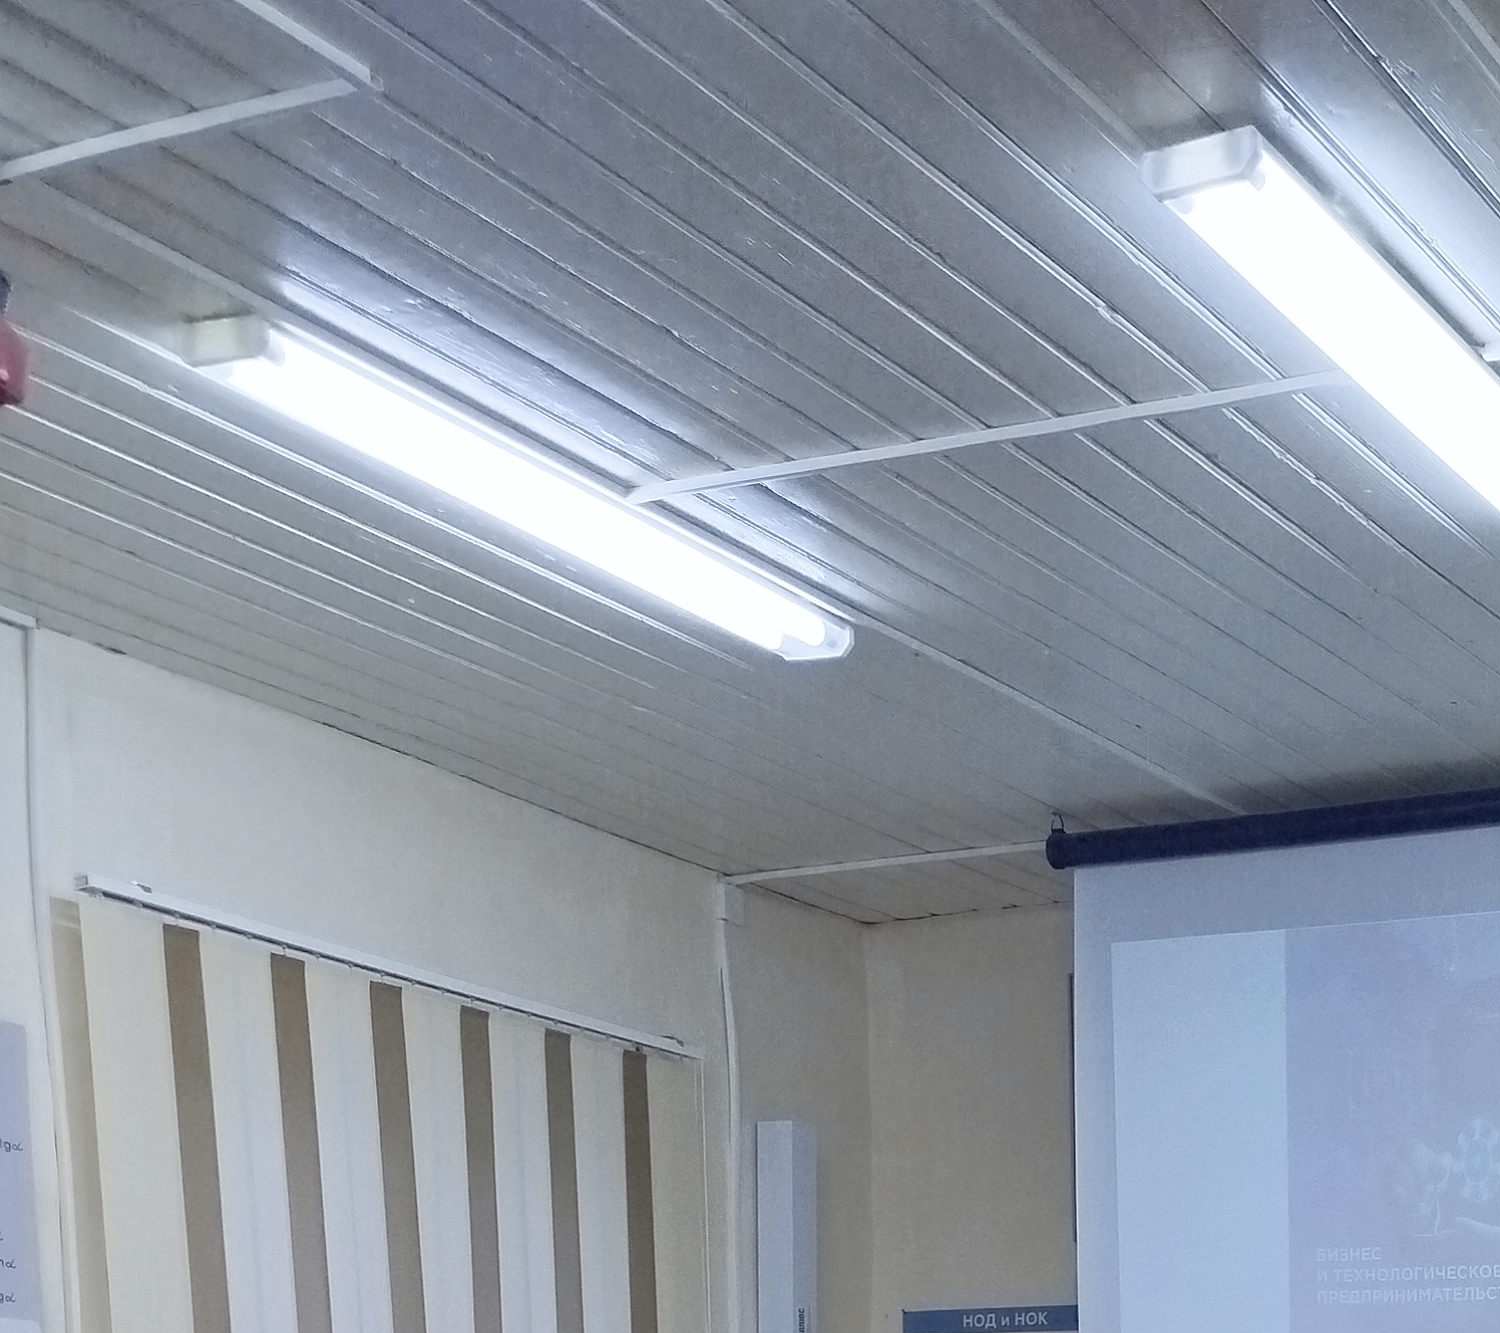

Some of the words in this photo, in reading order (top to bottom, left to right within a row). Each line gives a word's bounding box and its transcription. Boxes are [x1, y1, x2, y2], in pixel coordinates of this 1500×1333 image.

[1317, 1247, 1382, 1262] БИЗНЕС
[1317, 1270, 1328, 1282] И
[963, 1313, 997, 1329] НОД
[1001, 1318, 1010, 1326] и
[1015, 1312, 1049, 1326] НОК
